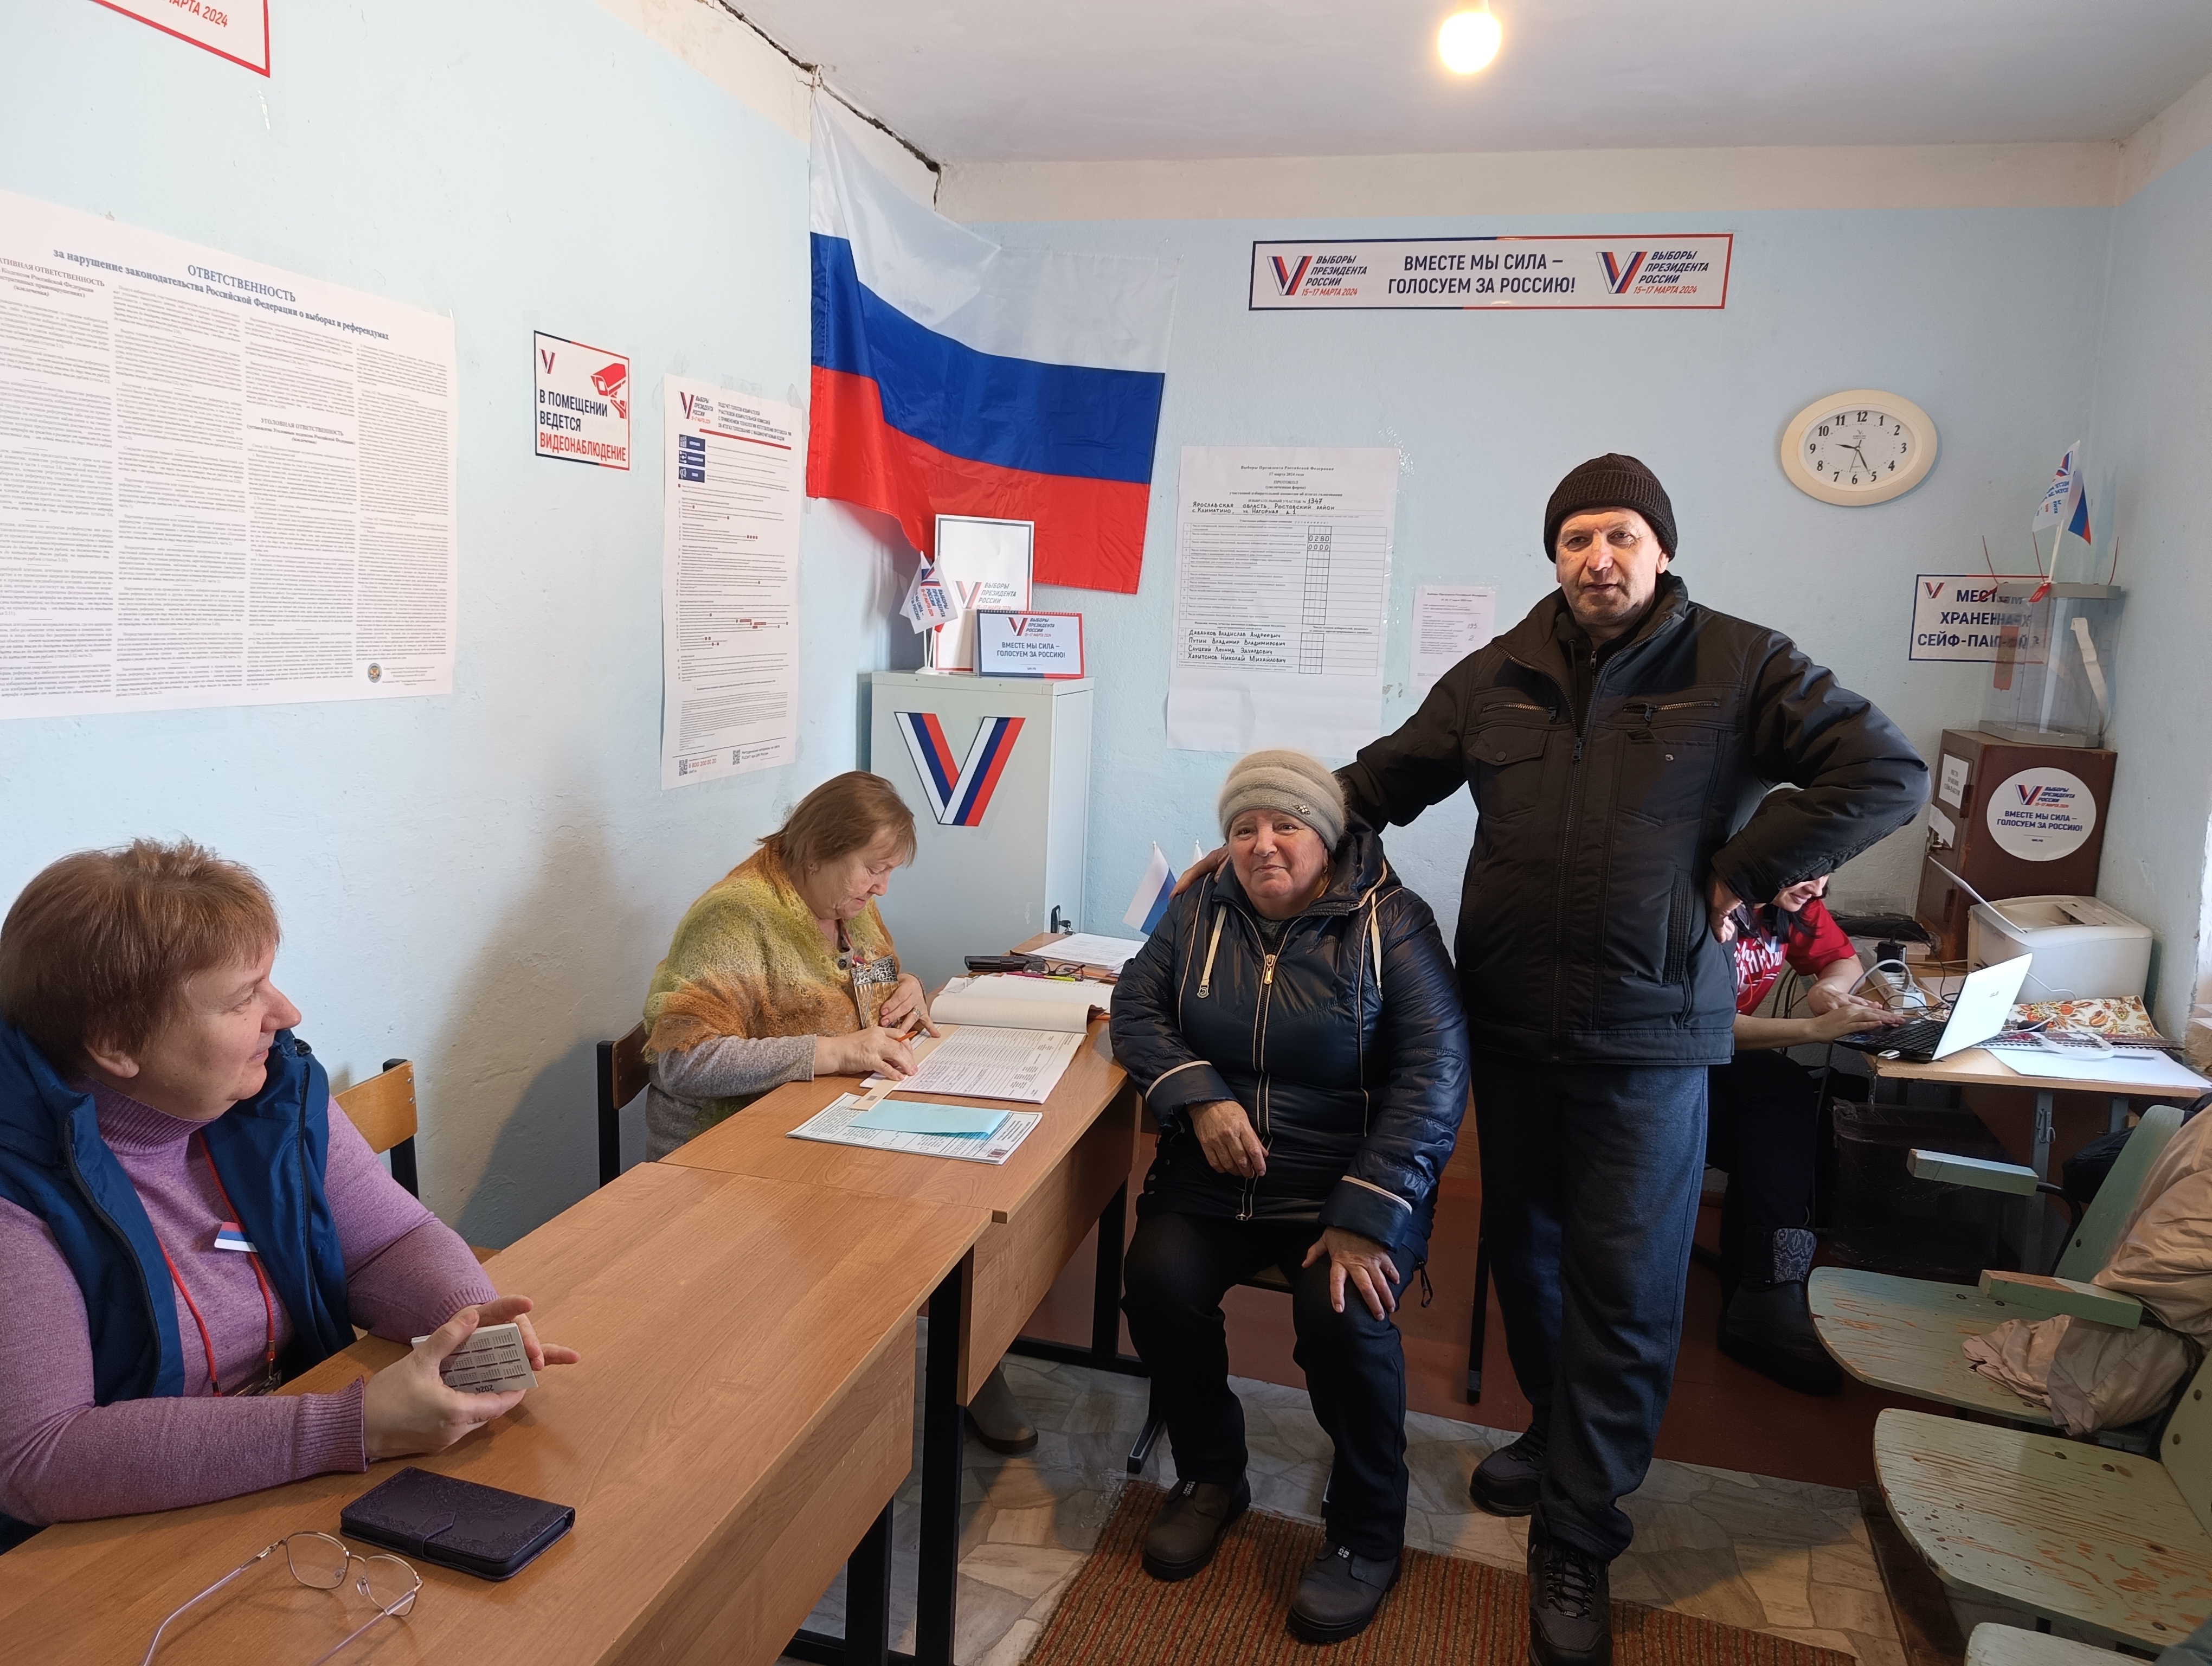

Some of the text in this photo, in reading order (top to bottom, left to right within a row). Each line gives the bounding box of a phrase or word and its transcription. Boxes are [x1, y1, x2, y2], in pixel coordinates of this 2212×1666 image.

[202, 6, 228, 28] 2024
[1315, 255, 1357, 265] ВЫБОРЫ
[1651, 250, 1698, 260] ВЫБОРЫ
[1404, 254, 1466, 271] ВМЕСТЕ
[1470, 254, 1499, 271] МЫ
[1503, 253, 1547, 270] СИЛА
[1644, 262, 1709, 273] ПРЕЗИДЕНТА
[35, 266, 105, 287] ОТВЕТСТВЕННОСТЬ
[1310, 266, 1367, 276] ПРЕЗИДЕНТА
[188, 265, 296, 302] ОТВЕТСТВЕННОСТЬ
[1306, 278, 1342, 286] РОССИИ
[1638, 274, 1681, 284] РОССИИ
[1388, 276, 1576, 294] ГОЛОСУЕМ ЗА РОССИЮ!
[1654, 286, 1679, 294] МАРТА
[1679, 285, 1697, 294] 2024
[53, 249, 65, 259] за
[67, 252, 124, 273] нарушение
[125, 266, 204, 292] законодательства
[205, 285, 252, 305] Российской
[253, 297, 297, 316] Федерации
[305, 312, 336, 326] выборах
[343, 321, 389, 340] референдумах
[1319, 288, 1342, 296] МАРТА
[1342, 287, 1358, 296] 2024
[539, 389, 608, 417] В ПОМЕЩЕНИИ
[540, 411, 581, 432] ВЕДЕТСЯ
[1835, 415, 1846, 426] 11
[1856, 411, 1868, 422] 12
[1879, 415, 1884, 426] 1
[261, 418, 294, 428] УГОЛОВНАЯ
[295, 424, 344, 436] ОТВЕТСТВЕННОСТЬ
[1818, 425, 1829, 437] 10
[1894, 425, 1901, 436] 2
[540, 432, 626, 462] ВИДЕОНАБЛЮДЕНИЕ
[1809, 443, 1816, 454] 9
[1900, 443, 1907, 453] 3
[1816, 460, 1823, 471] 8
[1888, 460, 1895, 471] 4
[1833, 471, 1840, 482] 7
[1851, 474, 1858, 484] 6
[1870, 471, 1877, 482] 5
[925, 588, 936, 606] РОССИИ
[931, 588, 946, 617] ПРЕЗИДЕНТА
[937, 589, 949, 610] ВЫБОРЫ
[2004, 810, 2034, 818] ВМЕСТЕ
[1997, 819, 2036, 828] ГОЛОСУЕМ
[2048, 822, 2082, 831] РОССИЮ!
[475, 1385, 494, 1393] 2024
